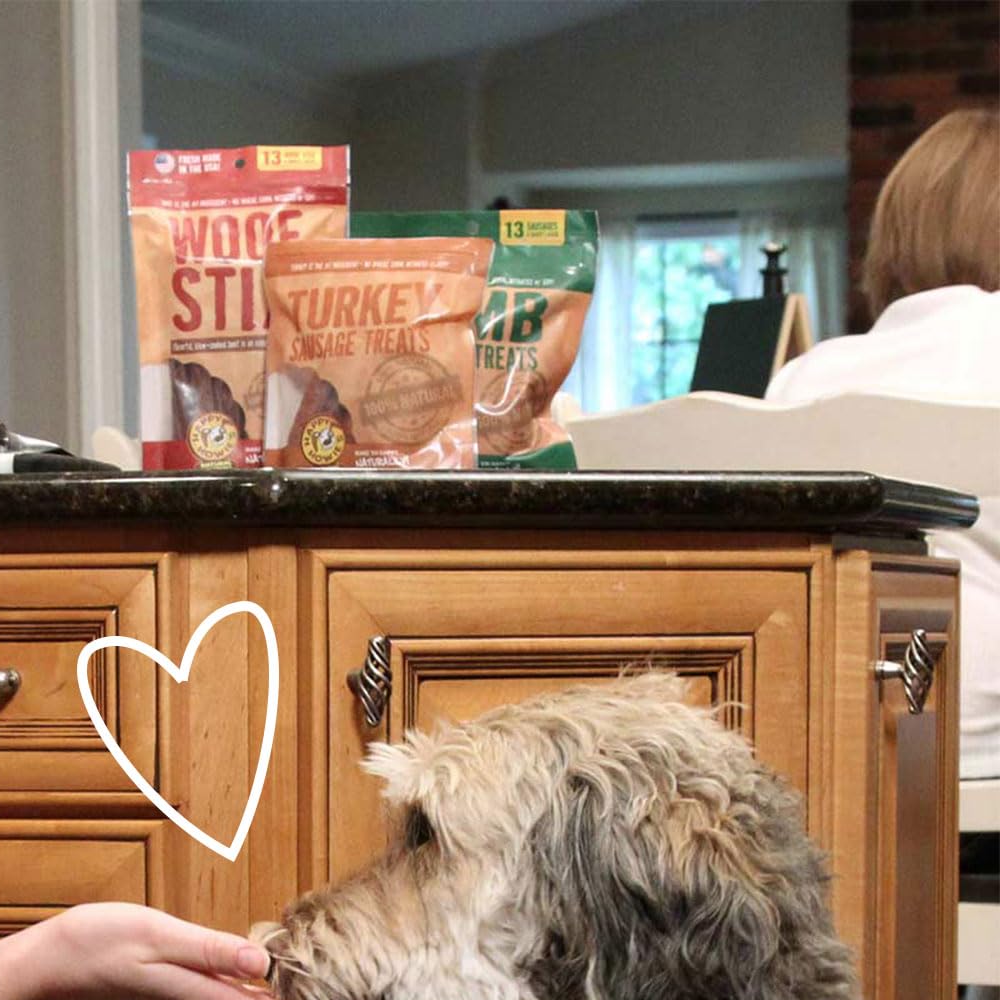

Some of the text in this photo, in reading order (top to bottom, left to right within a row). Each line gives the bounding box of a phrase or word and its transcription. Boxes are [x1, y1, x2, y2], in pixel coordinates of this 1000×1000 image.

[263, 151, 281, 166] 13
[504, 221, 525, 239] 13
[171, 266, 270, 333] STI
[287, 282, 443, 330] TURKEY
[288, 326, 431, 363] SAUSAGE TREATS
[474, 344, 539, 372] TREATS
